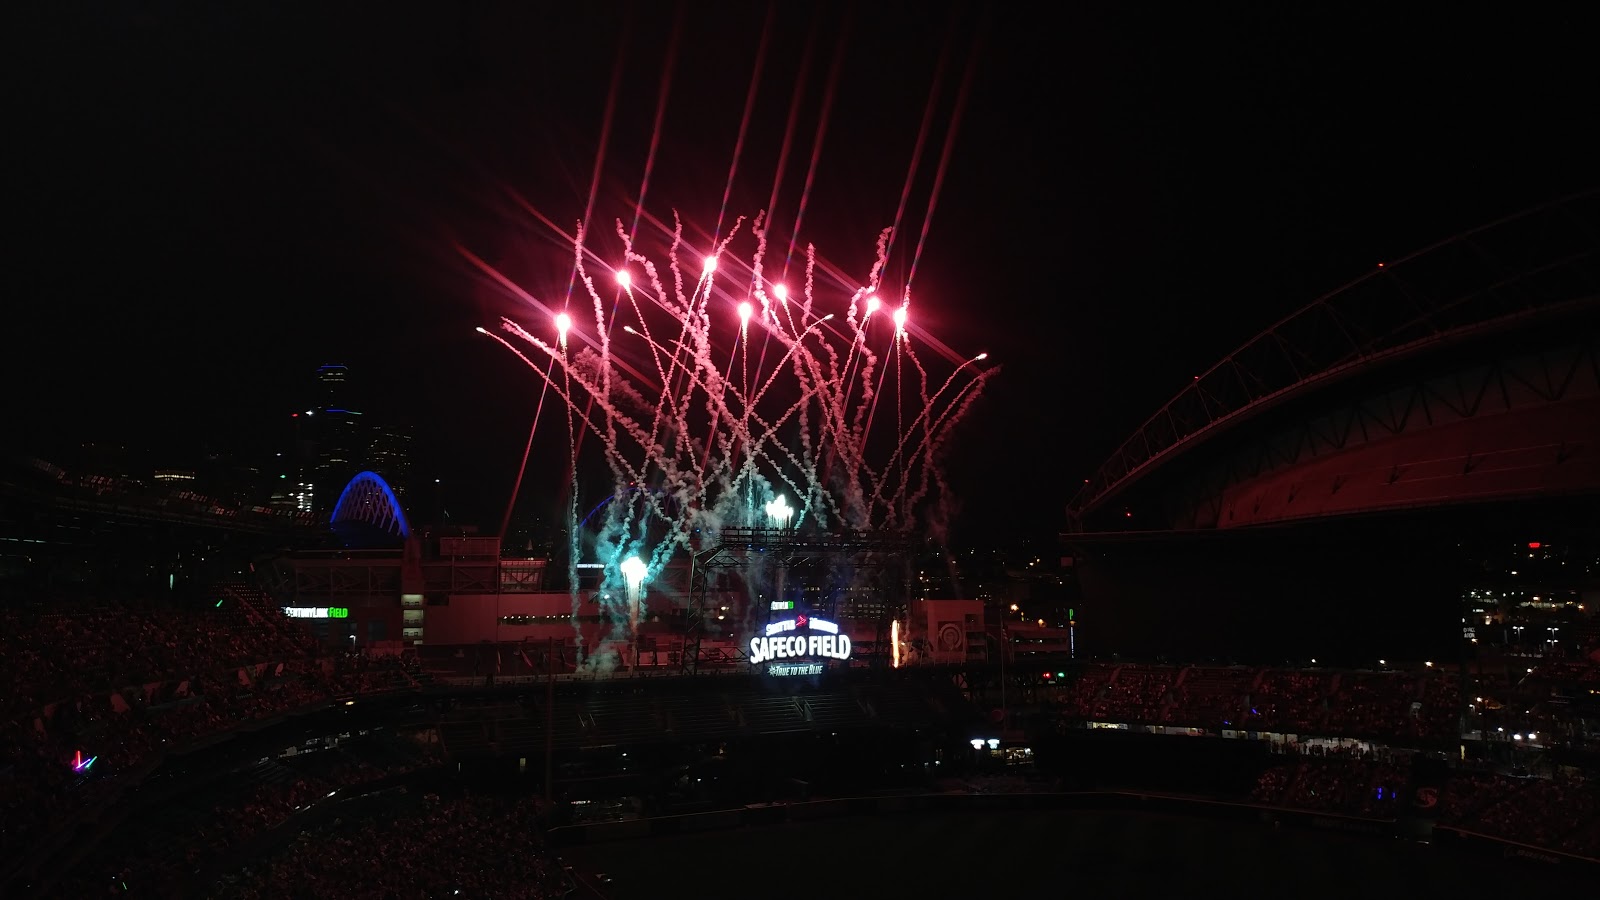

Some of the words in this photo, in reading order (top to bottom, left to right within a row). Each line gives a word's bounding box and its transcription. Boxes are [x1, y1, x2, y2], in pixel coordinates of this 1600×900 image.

[329, 607, 348, 618] FIELD
[750, 636, 806, 664] SAFECO
[809, 635, 851, 660] FIELD
[776, 665, 789, 676] TRUE
[790, 666, 798, 675] TO
[798, 665, 809, 675] THE
[809, 664, 823, 674] BLUE
